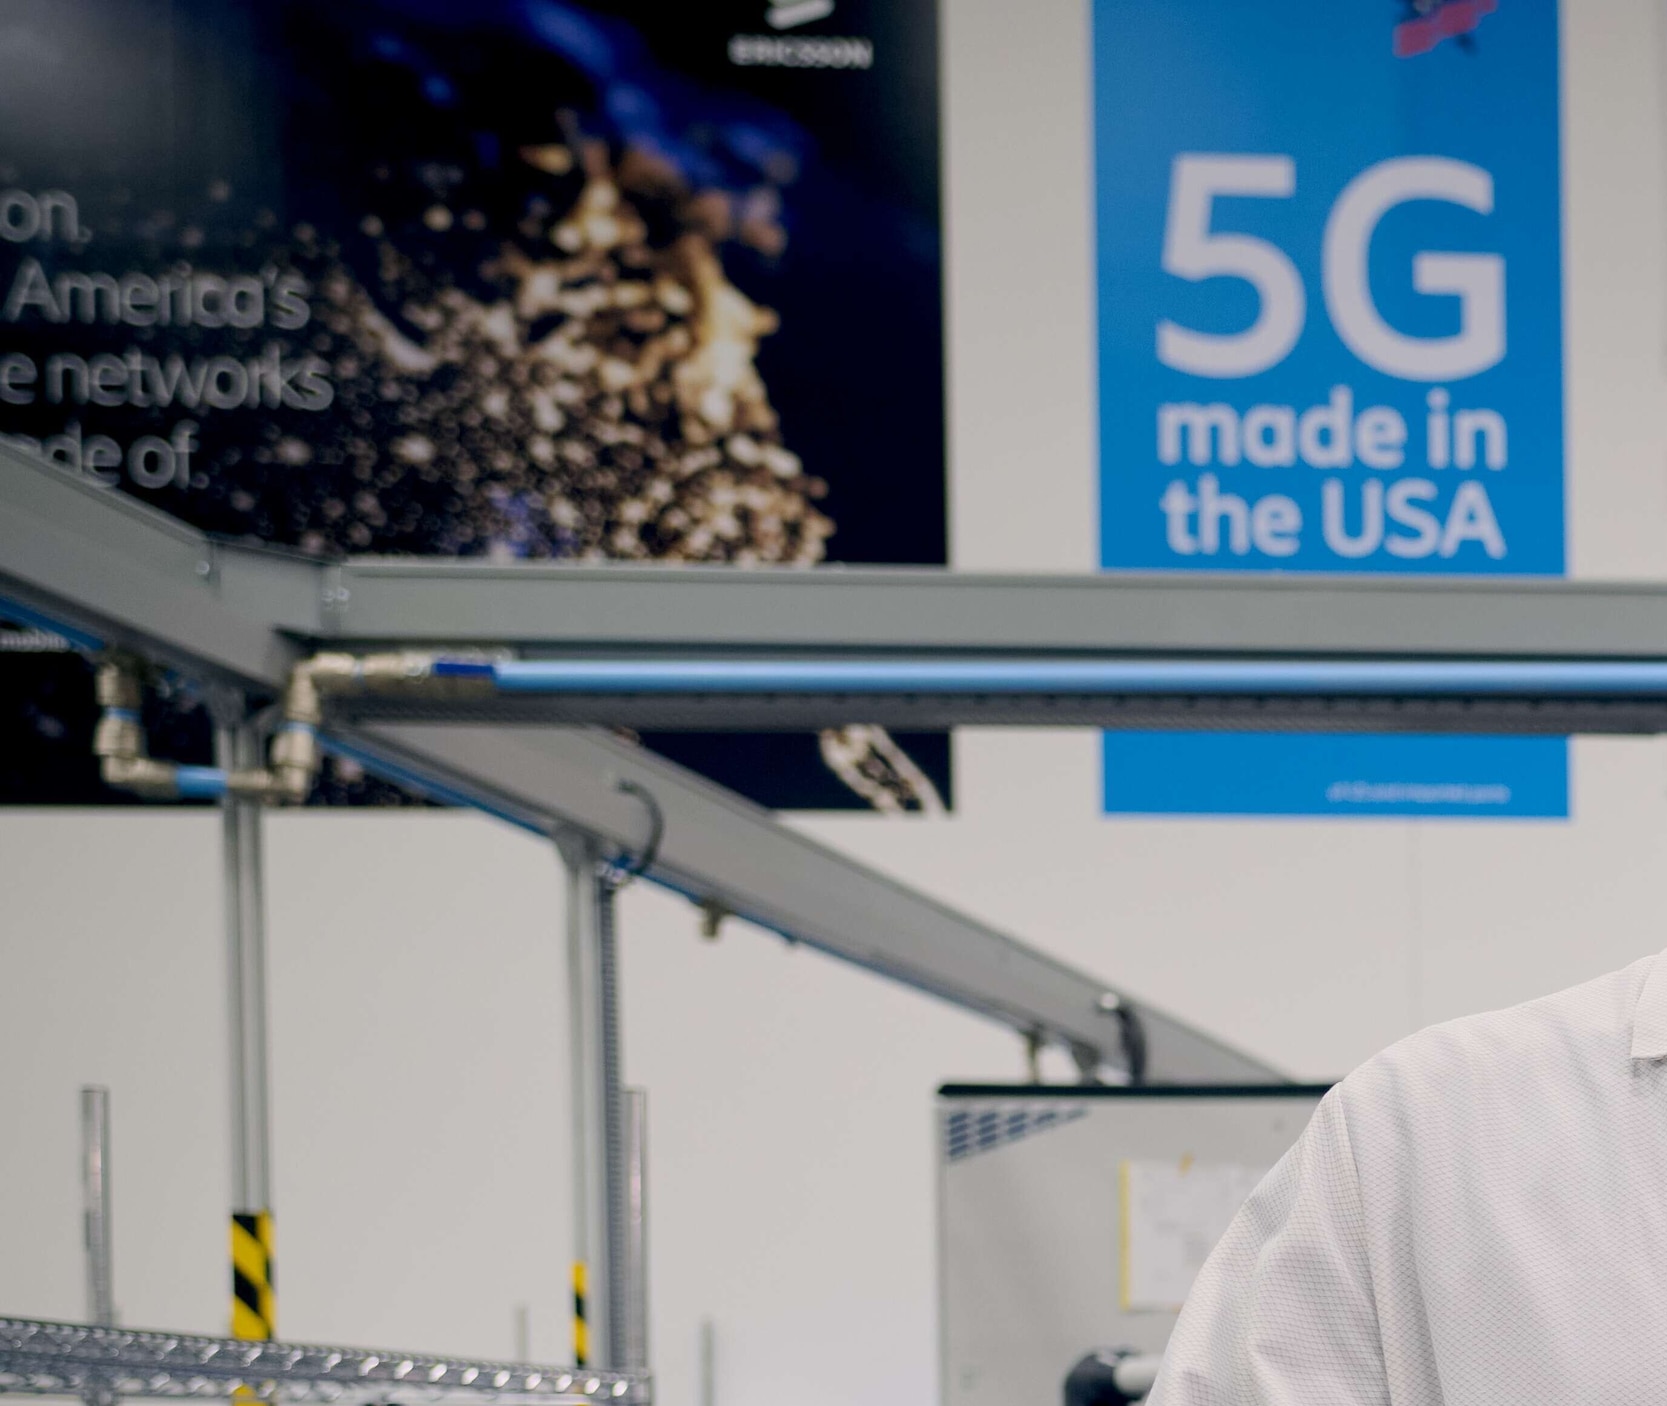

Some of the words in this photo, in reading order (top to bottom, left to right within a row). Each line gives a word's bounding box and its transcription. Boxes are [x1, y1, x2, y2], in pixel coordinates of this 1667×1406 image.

[727, 34, 873, 70] ERICSSON
[3, 256, 312, 330] America's
[1155, 152, 1507, 383] 5G
[46, 345, 336, 411] networks
[0, 418, 123, 488] de
[1157, 385, 1407, 468] made
[1426, 388, 1509, 470] in
[1159, 474, 1302, 555] the
[1321, 478, 1507, 559] USA
